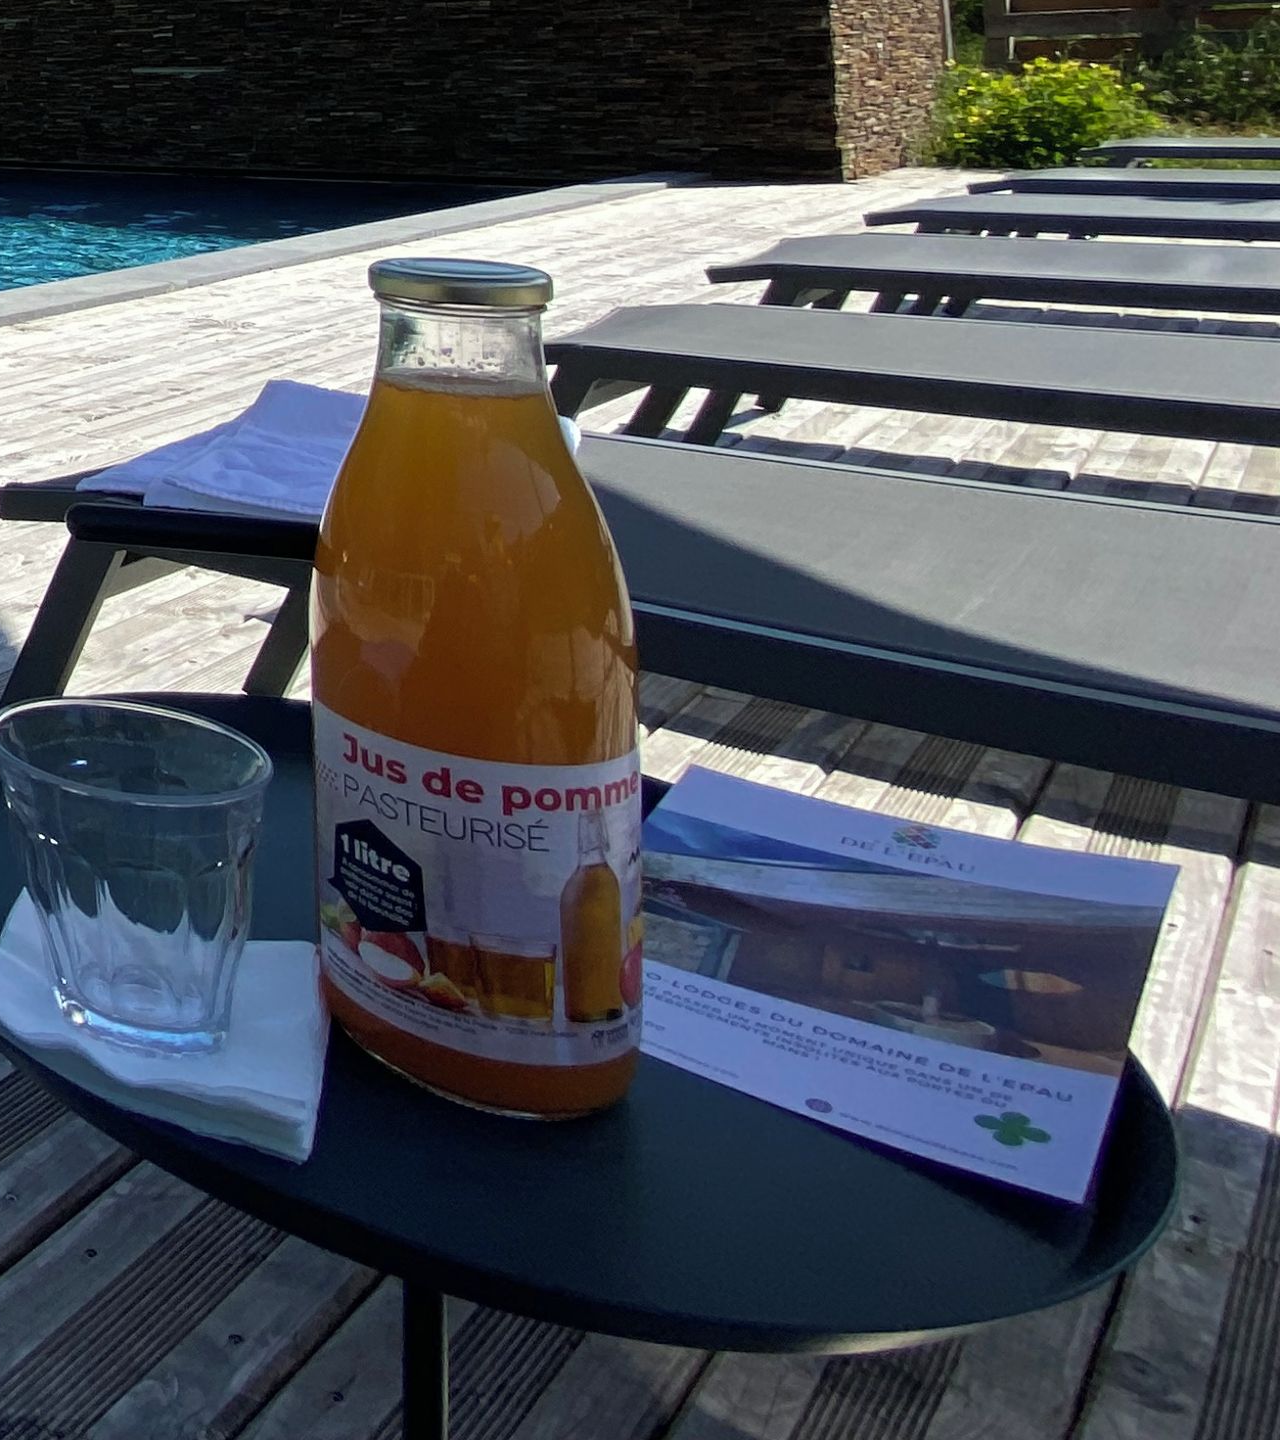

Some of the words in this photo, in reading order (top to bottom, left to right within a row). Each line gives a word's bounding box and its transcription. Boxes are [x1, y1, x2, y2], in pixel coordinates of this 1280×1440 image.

[342, 732, 407, 784] Jus
[422, 767, 484, 803] de
[502, 771, 638, 816] pomme
[343, 773, 550, 852] PASTEURISÉ
[341, 833, 349, 853] 1
[353, 839, 410, 882] litre
[770, 1012, 803, 1028] DU
[812, 1025, 929, 1066] DOMAINE
[939, 1062, 971, 1078] DE
